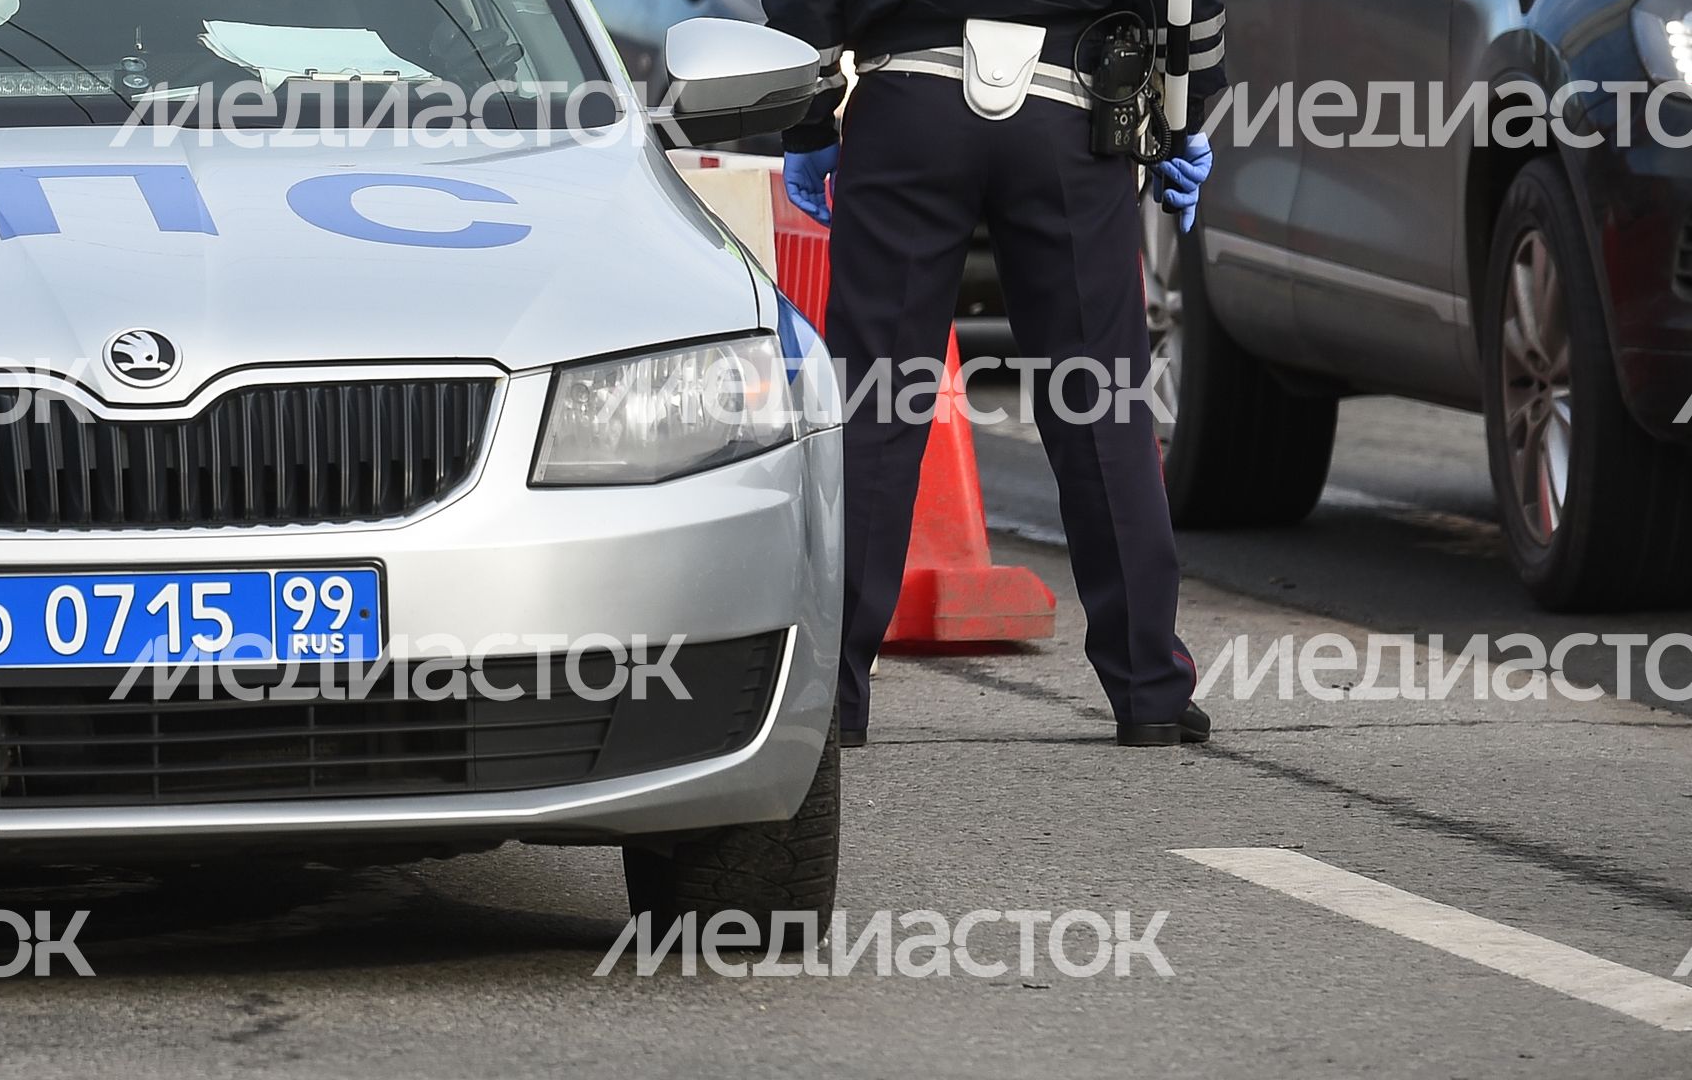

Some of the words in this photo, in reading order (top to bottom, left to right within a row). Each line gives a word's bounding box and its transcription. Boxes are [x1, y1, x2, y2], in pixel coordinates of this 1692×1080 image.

[44, 581, 234, 656] 0715
[281, 575, 354, 632] 99
[291, 633, 345, 655] RUS
